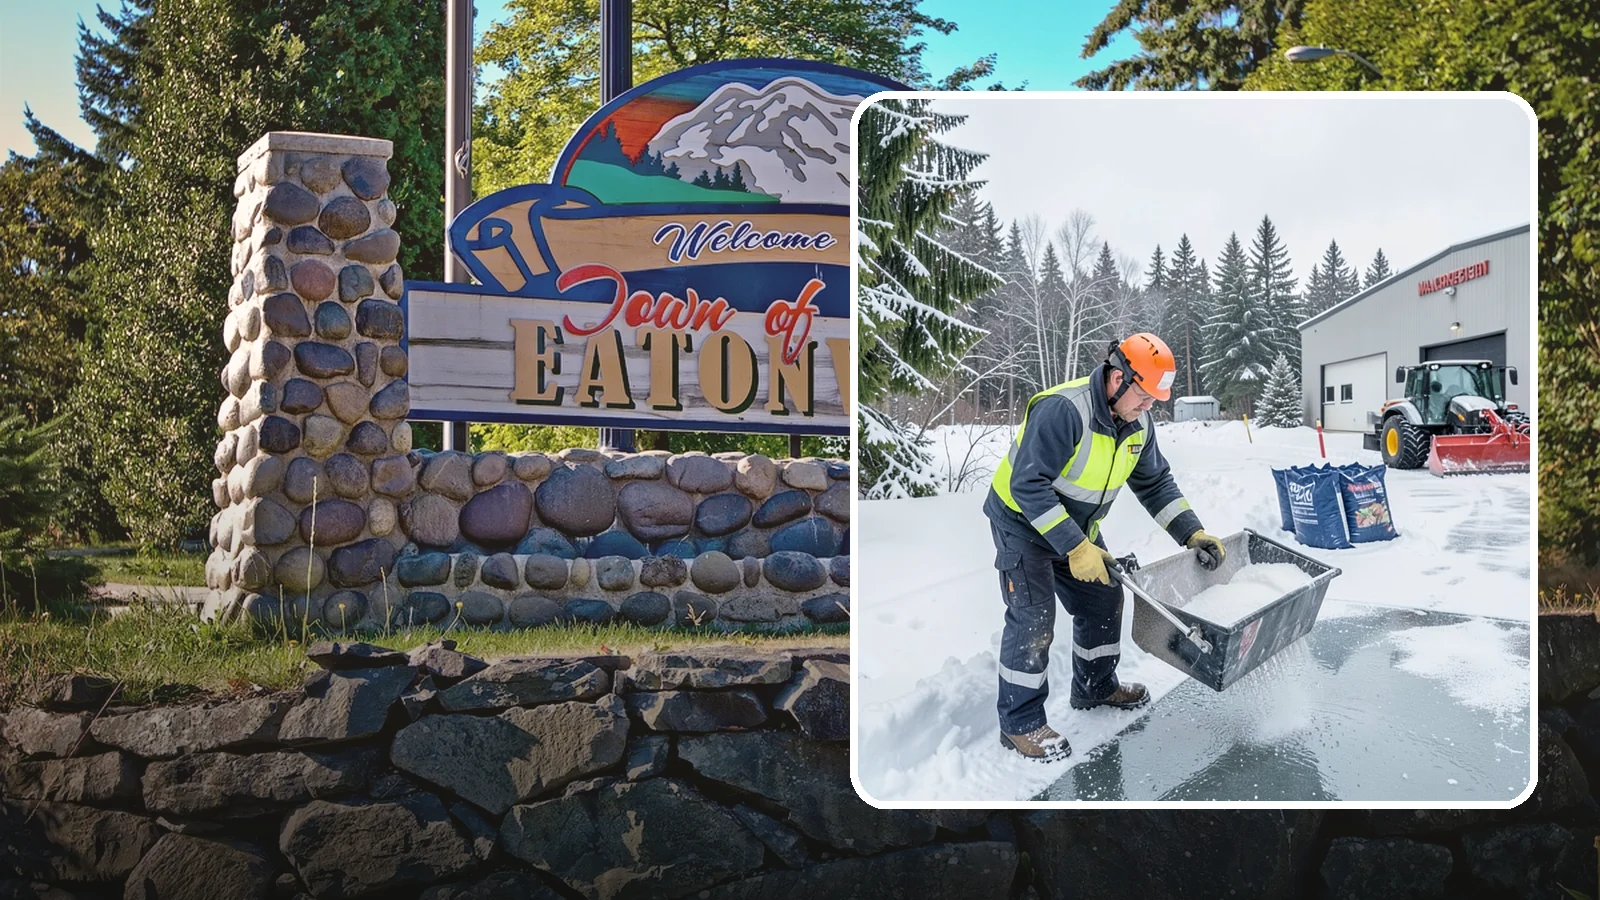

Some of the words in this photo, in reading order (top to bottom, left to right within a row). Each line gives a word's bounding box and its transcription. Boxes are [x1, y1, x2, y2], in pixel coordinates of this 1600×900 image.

[653, 220, 837, 263] Welcome
[557, 263, 736, 336] Town
[764, 278, 826, 365] of
